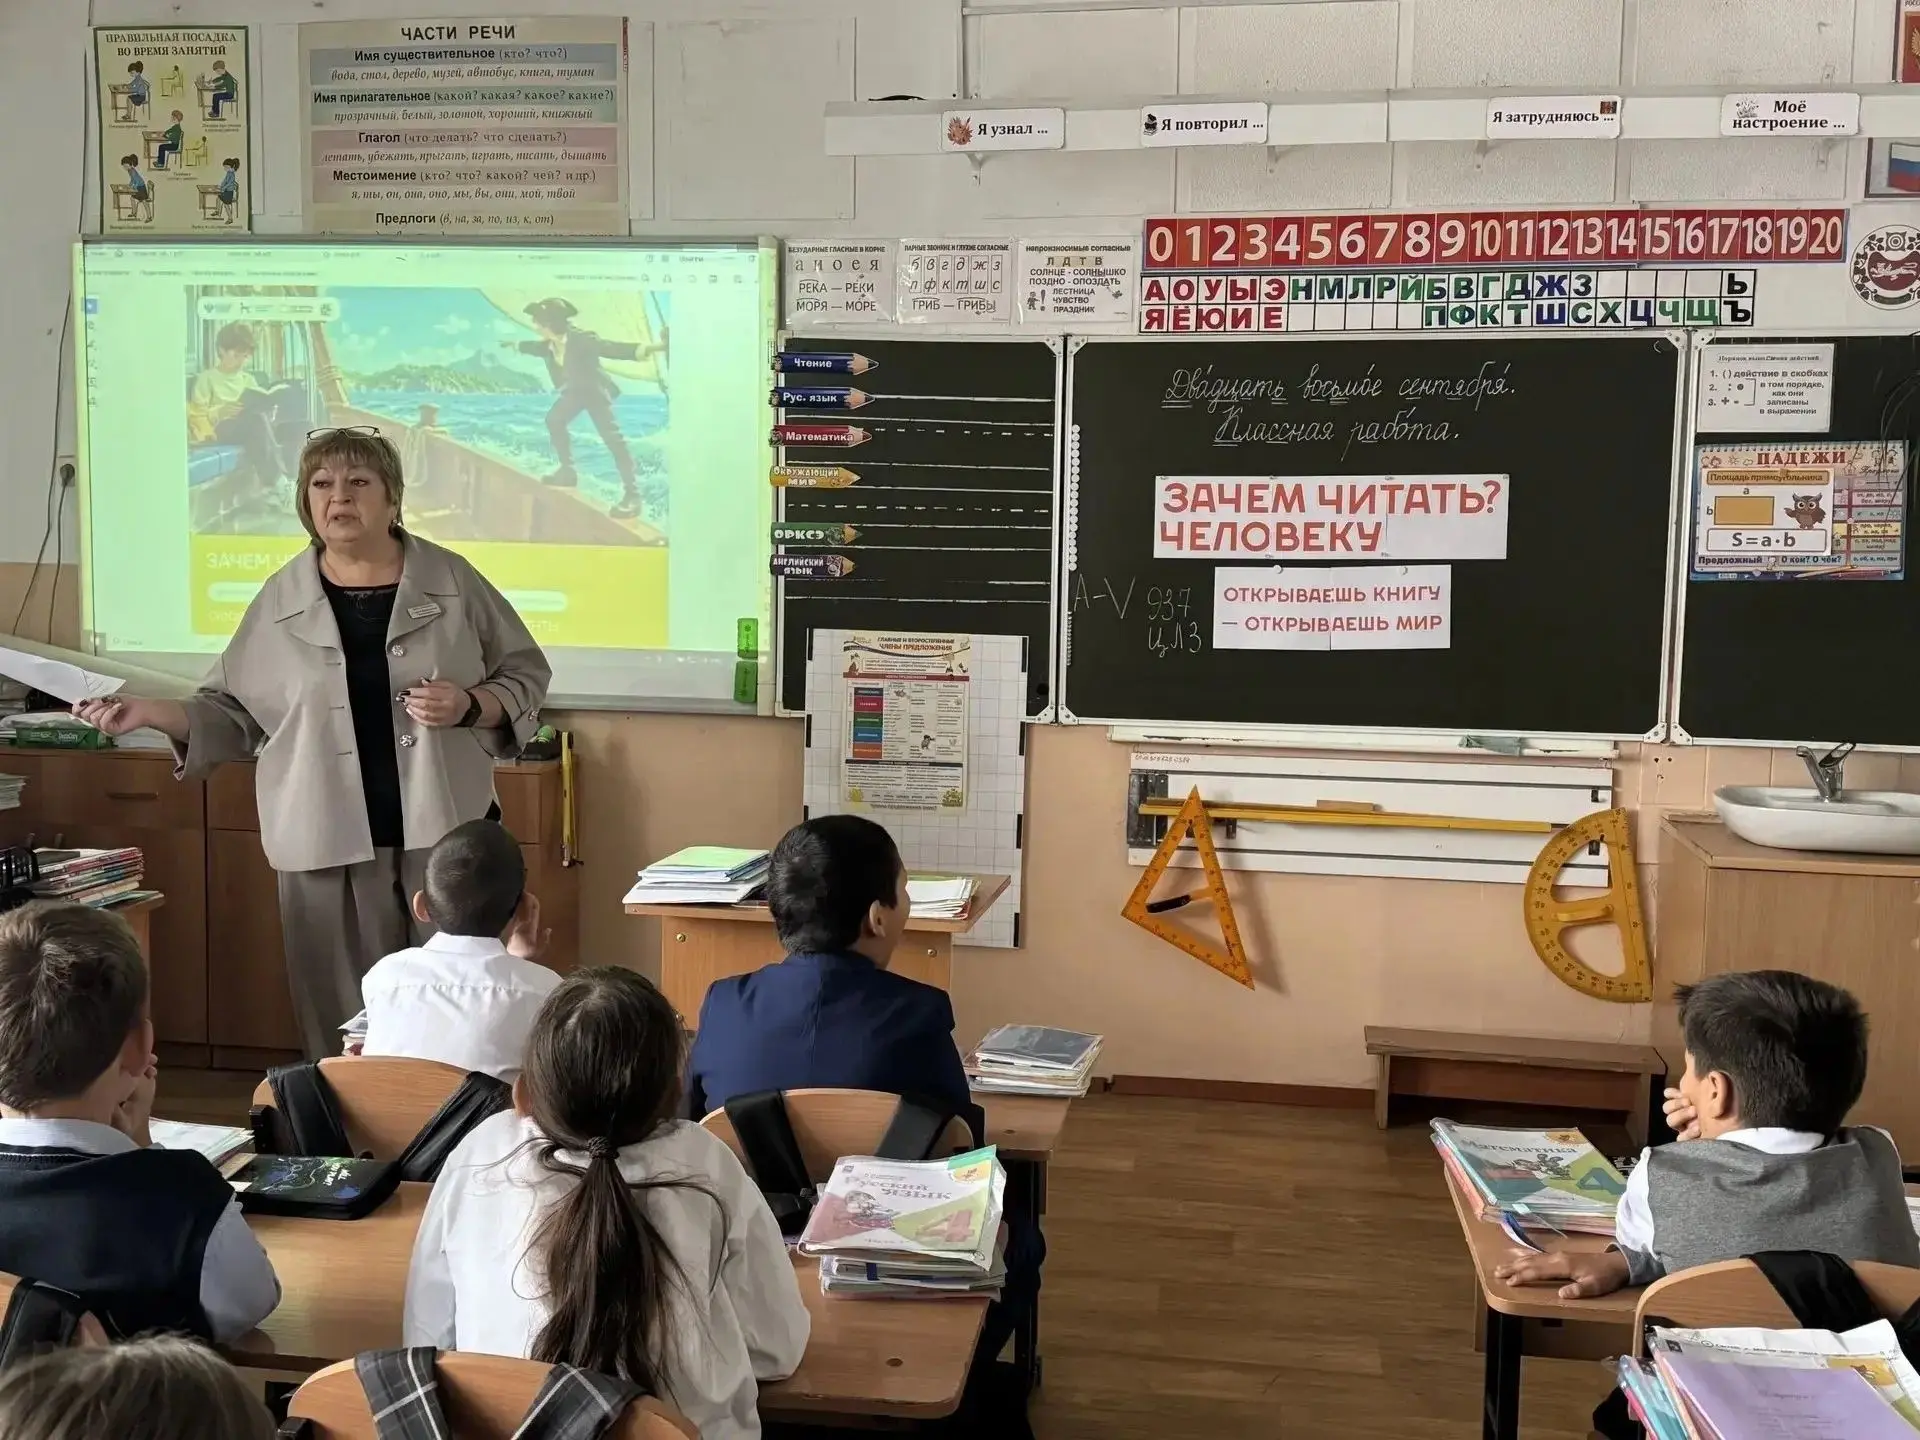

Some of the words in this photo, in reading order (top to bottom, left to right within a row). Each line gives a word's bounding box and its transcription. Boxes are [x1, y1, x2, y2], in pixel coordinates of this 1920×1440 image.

[105, 32, 179, 43] ПРАВИЛЬНАЯ
[182, 32, 237, 42] ПОСАДКА
[401, 26, 457, 41] ЧАСТИ
[468, 25, 515, 39] РЕЧИ
[117, 47, 131, 56] ВО
[134, 46, 169, 56] ВРЕМЯ
[171, 45, 226, 56] ЗАНЯТИЙ
[354, 50, 379, 61] Имя
[383, 48, 495, 63] существительное
[314, 92, 337, 103] Имя
[340, 91, 430, 104] прилагательное
[1773, 99, 1807, 114] Моё
[1492, 112, 1503, 123] Я
[1505, 111, 1599, 127] затрудняюсь
[1732, 116, 1829, 131] настроение
[977, 123, 988, 136] Я
[990, 123, 1033, 139] узнал
[1160, 118, 1172, 131] Я
[1175, 118, 1248, 134] повторил
[358, 132, 400, 143] Глагол
[333, 170, 417, 181] Местоимение
[375, 212, 436, 225] Предлоги
[1150, 227, 1173, 261] 0
[1185, 226, 1200, 261] 1
[1211, 225, 1236, 261] 2
[1244, 224, 1267, 260] 3
[1274, 224, 1300, 260] 4
[1308, 223, 1332, 259] 5
[1339, 222, 1365, 259] 6
[1373, 222, 1398, 258] 7
[1404, 221, 1431, 258] 8
[1439, 220, 1466, 257] 9
[1470, 219, 1501, 257] 10
[1505, 219, 1533, 256] 11
[1538, 219, 1569, 255] 12
[1572, 218, 1602, 255] 13
[1606, 218, 1637, 255] 14
[1640, 217, 1671, 255] 15
[1673, 217, 1704, 254] 16
[1708, 217, 1739, 254] 17
[1741, 216, 1773, 254] 18
[1776, 216, 1807, 254] 19
[1809, 216, 1842, 254] 20
[1030, 268, 1065, 276] СОЛНЦЕ
[799, 282, 827, 293] РЕКА
[845, 282, 874, 293] РЕКИ
[1029, 278, 1065, 286] ПОЗДНО
[1144, 280, 1166, 300] А
[1173, 279, 1195, 301] О
[1204, 280, 1223, 300] У
[1230, 279, 1257, 300] Ы
[1264, 278, 1286, 300] Э
[1292, 279, 1312, 300] Н
[1319, 278, 1343, 300] М
[1348, 277, 1371, 298] Л
[1377, 277, 1396, 298] Р
[1401, 274, 1421, 300] Й
[1426, 278, 1446, 298] Б
[1455, 277, 1474, 298] В
[1482, 278, 1500, 297] Г
[1505, 274, 1531, 299] Д
[1535, 274, 1568, 295] Ж
[1573, 274, 1592, 295] З
[1727, 273, 1748, 295] Ь
[1052, 288, 1096, 296] ЛЕСТНИЦА
[796, 301, 828, 312] МОРЯ
[845, 301, 877, 312] МОРЕ
[912, 300, 940, 310] ГРИБ
[1052, 296, 1089, 304] ЧУВСТВО
[794, 357, 833, 369] Чтение
[782, 391, 806, 405] Рус.
[809, 394, 837, 403] язык
[1214, 405, 1335, 441] Классная
[785, 431, 854, 442] Математика
[1757, 452, 1846, 467] ПАДЕЖИ
[1163, 481, 1306, 515] ЗАЧЕМ
[1318, 480, 1502, 515] ЧИТАТЬ?
[774, 529, 825, 540] ОРКСЭ
[1160, 521, 1383, 552] ЧЕЛОВЕКУ
[1223, 587, 1367, 603] ОТКРЫВАЕШЬ
[1373, 585, 1441, 601] КНИГУ
[1245, 616, 1389, 633] ОТКРЫВАЕШЬ
[1396, 615, 1443, 631] МИР
